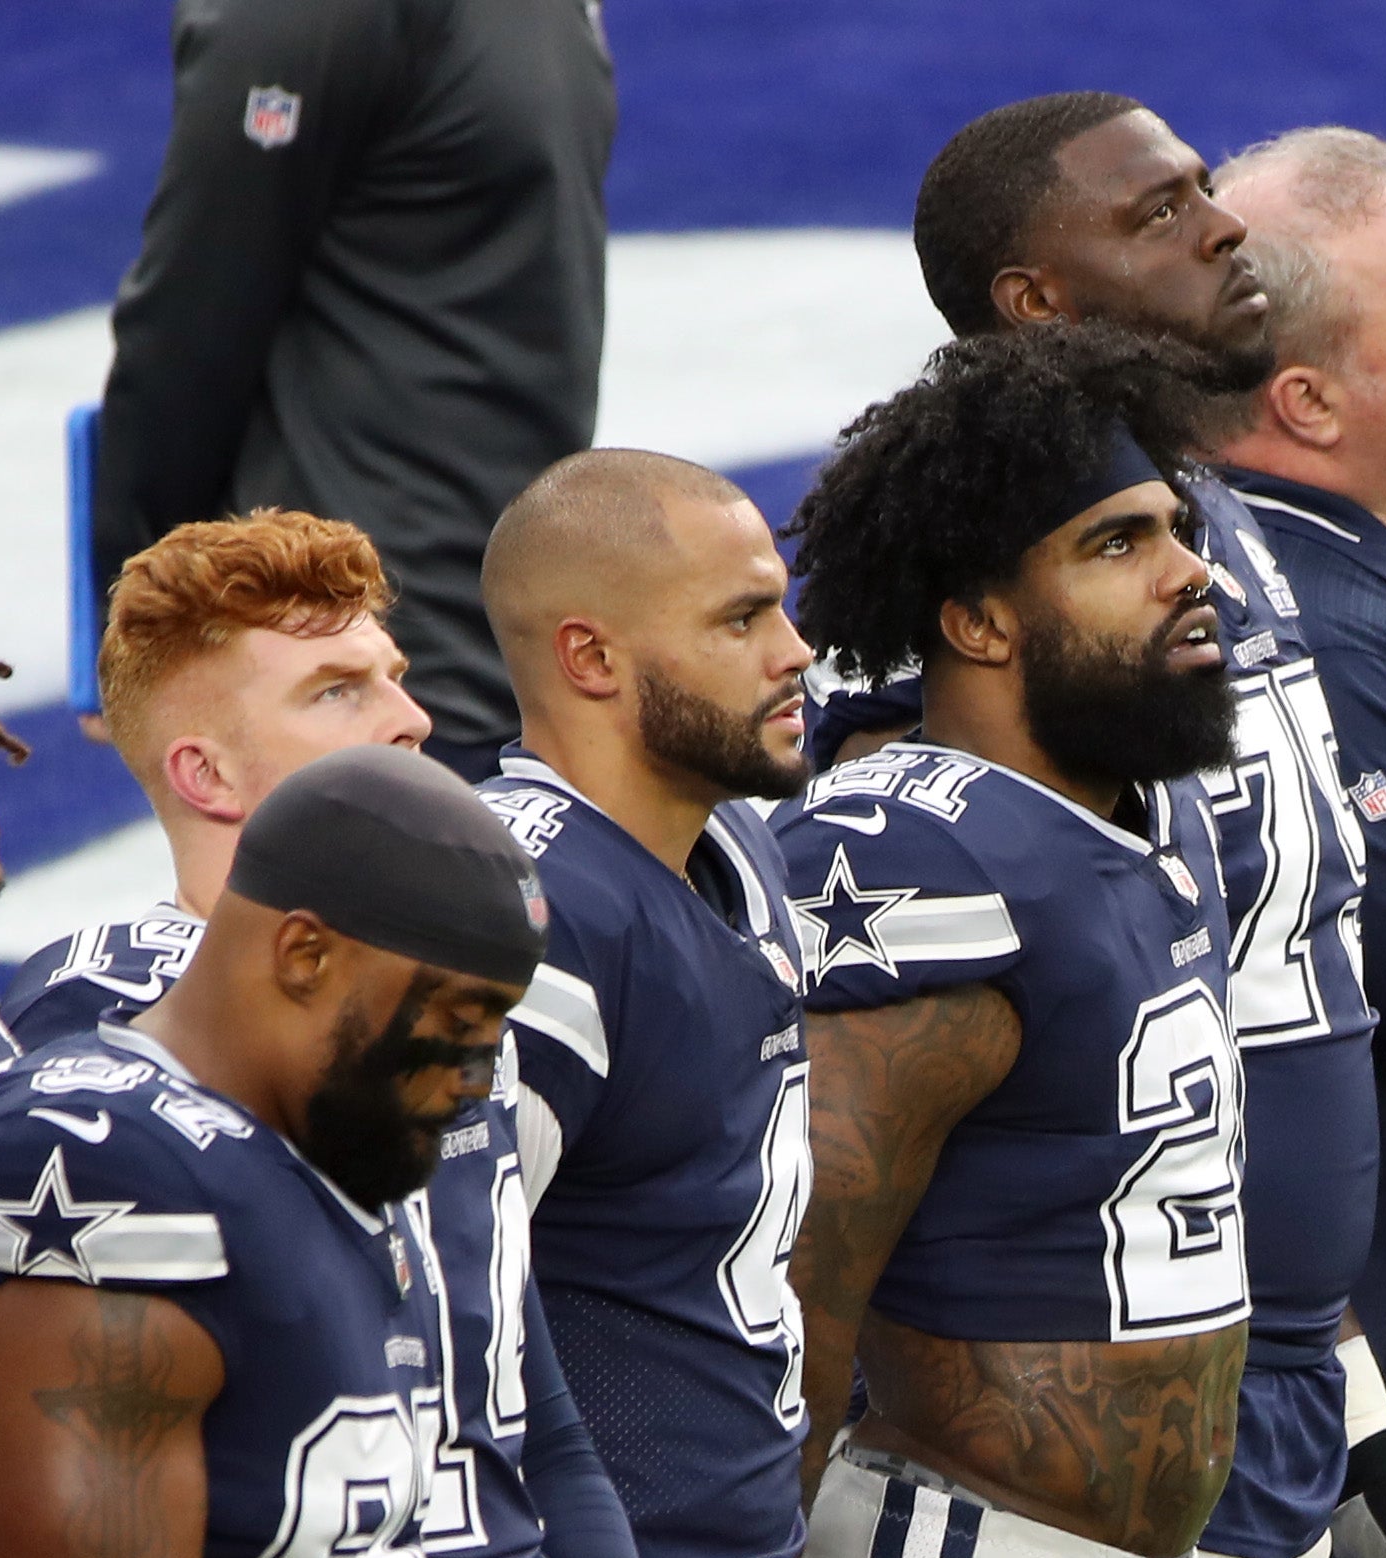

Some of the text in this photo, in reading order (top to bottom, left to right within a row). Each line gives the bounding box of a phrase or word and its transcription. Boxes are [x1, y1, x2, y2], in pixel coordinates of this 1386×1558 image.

[476, 782, 570, 858] 4
[803, 751, 989, 823] 21
[44, 903, 210, 989] 14
[1099, 976, 1254, 1343] 2
